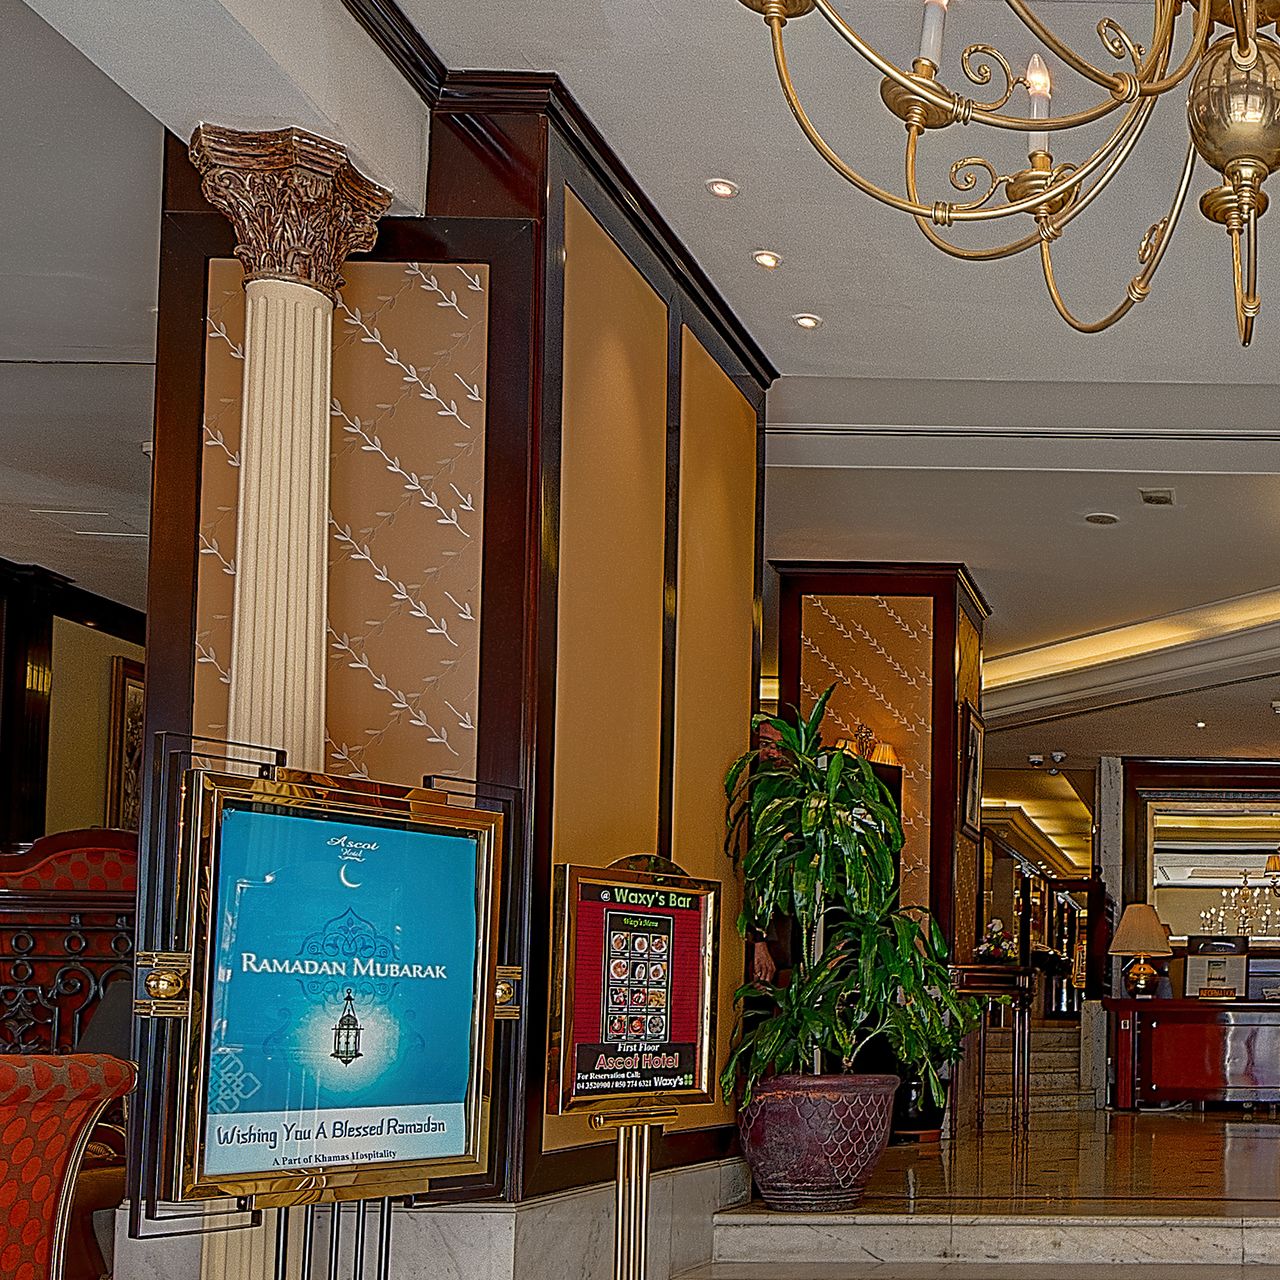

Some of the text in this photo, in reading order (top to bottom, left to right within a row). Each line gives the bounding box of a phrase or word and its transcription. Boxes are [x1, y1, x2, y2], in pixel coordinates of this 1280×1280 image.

[326, 835, 380, 850] Ascot
[614, 888, 666, 908] Waxy's
[669, 893, 692, 908] Bar
[241, 952, 448, 979] RAMADAN MUBARAK
[617, 1043, 660, 1052] First Floor
[595, 1052, 679, 1070] Ascot Hotel
[577, 1072, 589, 1080] For
[590, 1072, 626, 1080] Reservation
[653, 1076, 684, 1087] Waxy's
[217, 1116, 446, 1149] Wishing You A Blessed Ramadan
[272, 1149, 398, 1166] A Part of Khamas Hospitality
